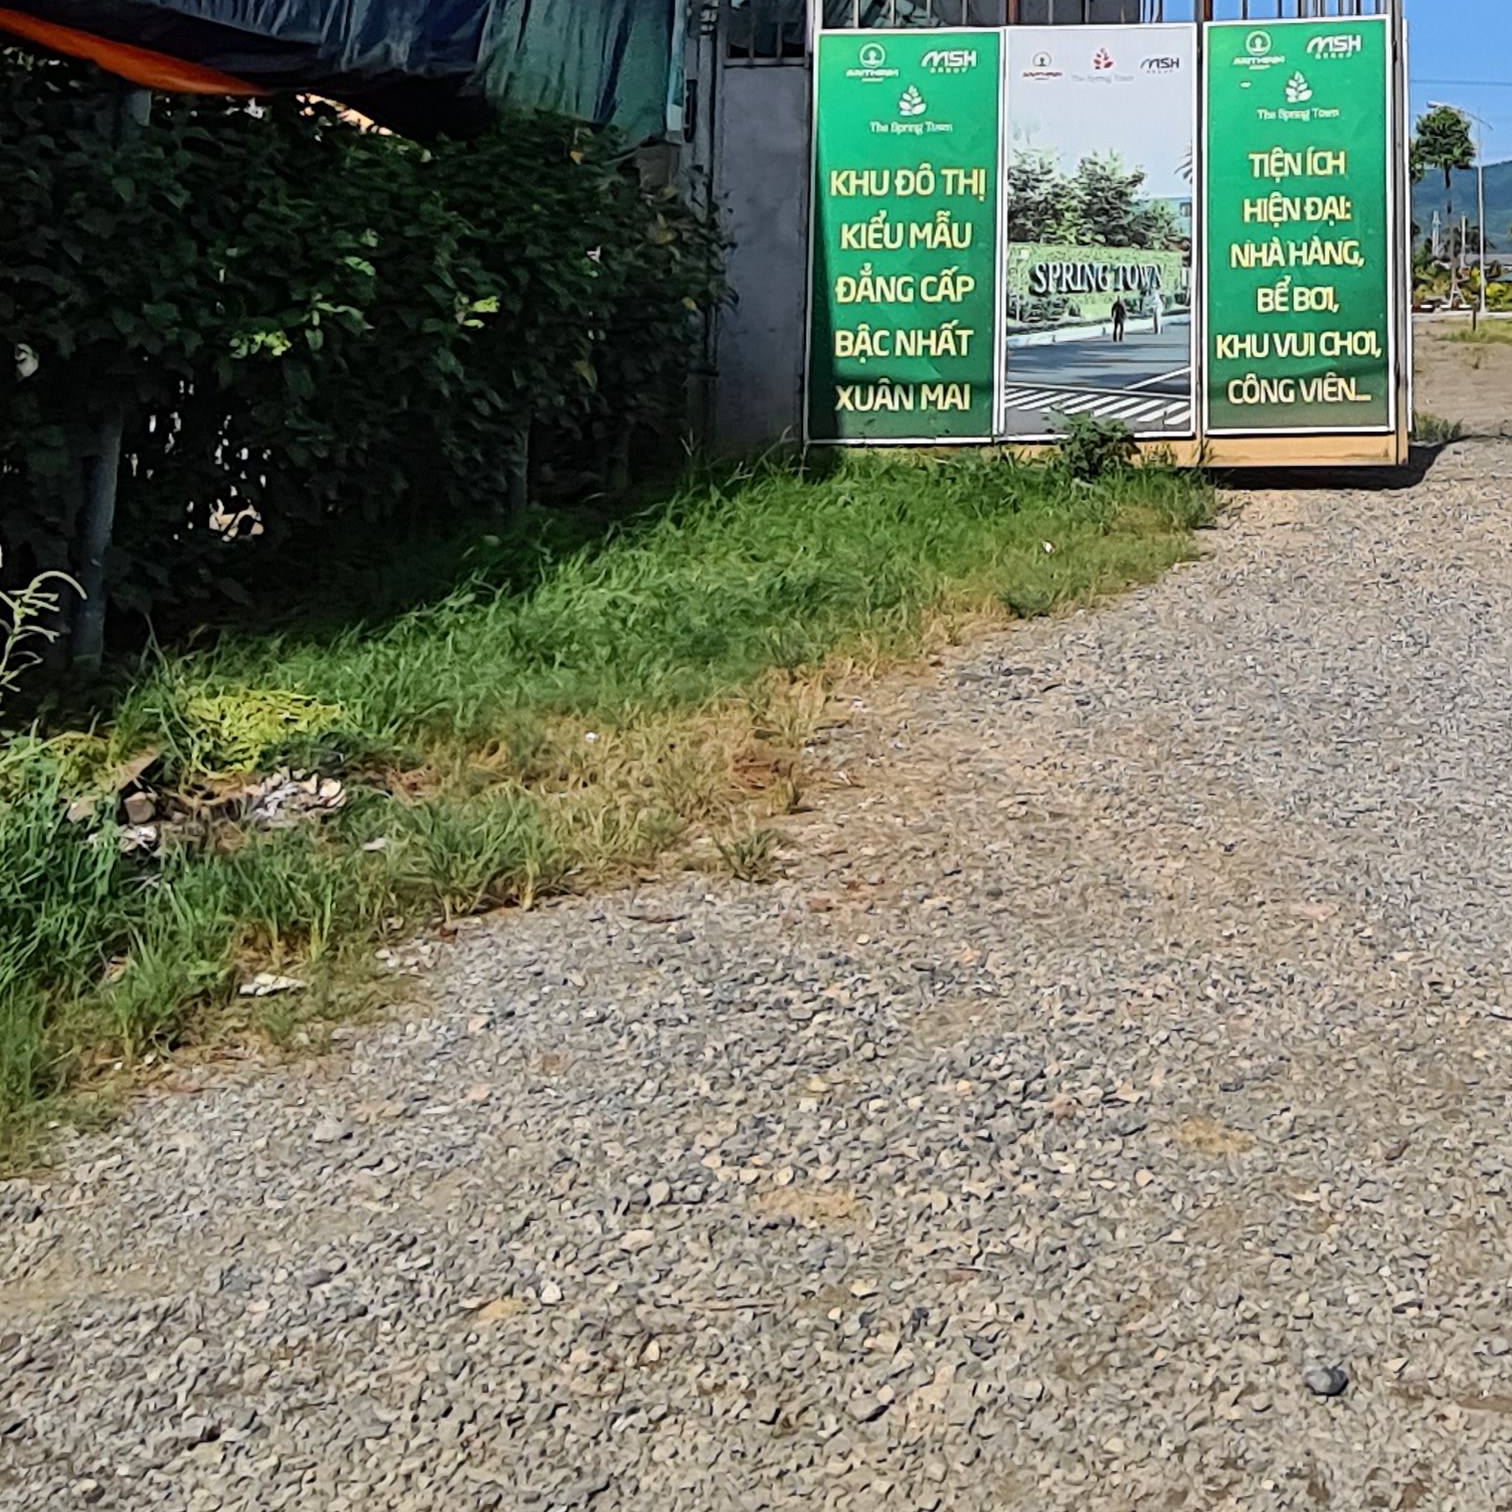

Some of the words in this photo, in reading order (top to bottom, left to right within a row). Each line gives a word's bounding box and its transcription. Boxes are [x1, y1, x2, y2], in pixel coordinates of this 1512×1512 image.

[830, 169, 890, 196] KHU
[894, 162, 935, 196] ĐÔ
[940, 168, 986, 202] THỊ
[1248, 146, 1302, 183] TIỆN
[1306, 145, 1346, 176] ÍCH
[1243, 191, 1301, 228] HIỆN
[1304, 195, 1352, 227] ĐẠI:
[840, 209, 904, 249] KIỂU
[909, 210, 972, 249] MẪU
[1230, 236, 1286, 268] NHÀ
[1289, 235, 1366, 268] HÀNG,
[835, 263, 914, 303] ĐẲNG
[920, 265, 975, 303] CẤP
[1031, 261, 1111, 295] SPRING
[1115, 263, 1161, 291] TOWN
[1257, 275, 1292, 313] BỂ
[834, 323, 890, 364] BẬC
[895, 319, 974, 356] NHẤT
[1216, 333, 1269, 359] KHU
[1273, 332, 1315, 358] VUI
[1319, 331, 1382, 358] CHƠI,
[835, 377, 914, 411] XUÂN
[920, 384, 971, 411] MAI
[1228, 373, 1295, 404] CÔNG
